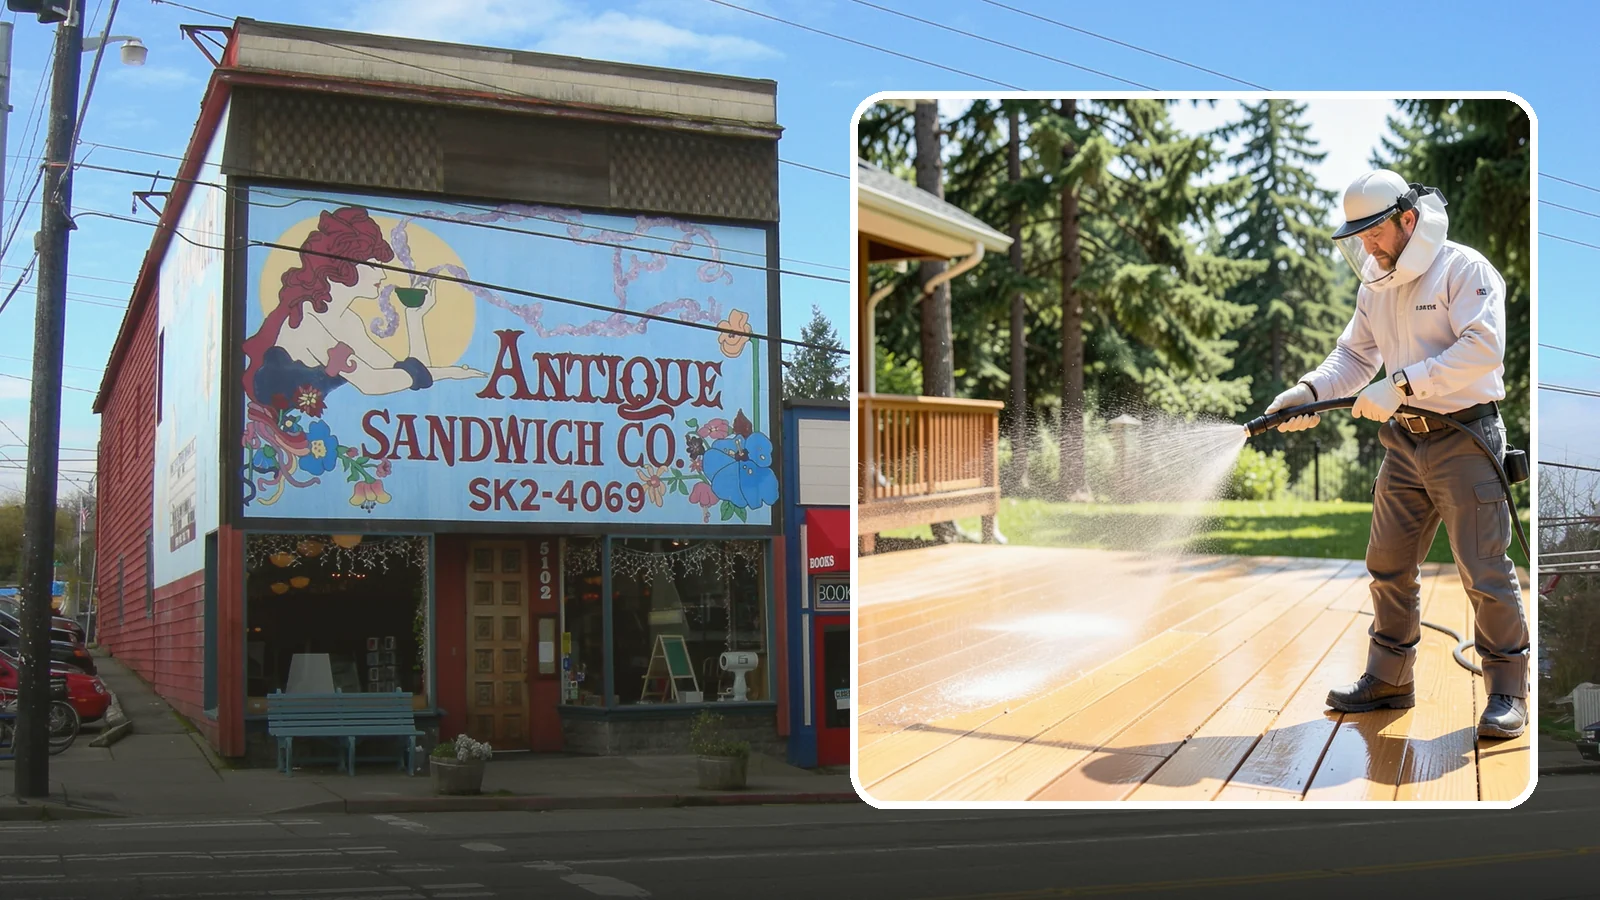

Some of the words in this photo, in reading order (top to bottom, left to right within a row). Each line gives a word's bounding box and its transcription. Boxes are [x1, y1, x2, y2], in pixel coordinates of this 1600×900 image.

[475, 329, 723, 420] ANTIQUE
[360, 408, 604, 467] SANDWICH
[617, 421, 684, 469] CO.
[468, 477, 646, 513] SK2-4069
[540, 541, 551, 600] 5102
[809, 555, 835, 569] BOOKS
